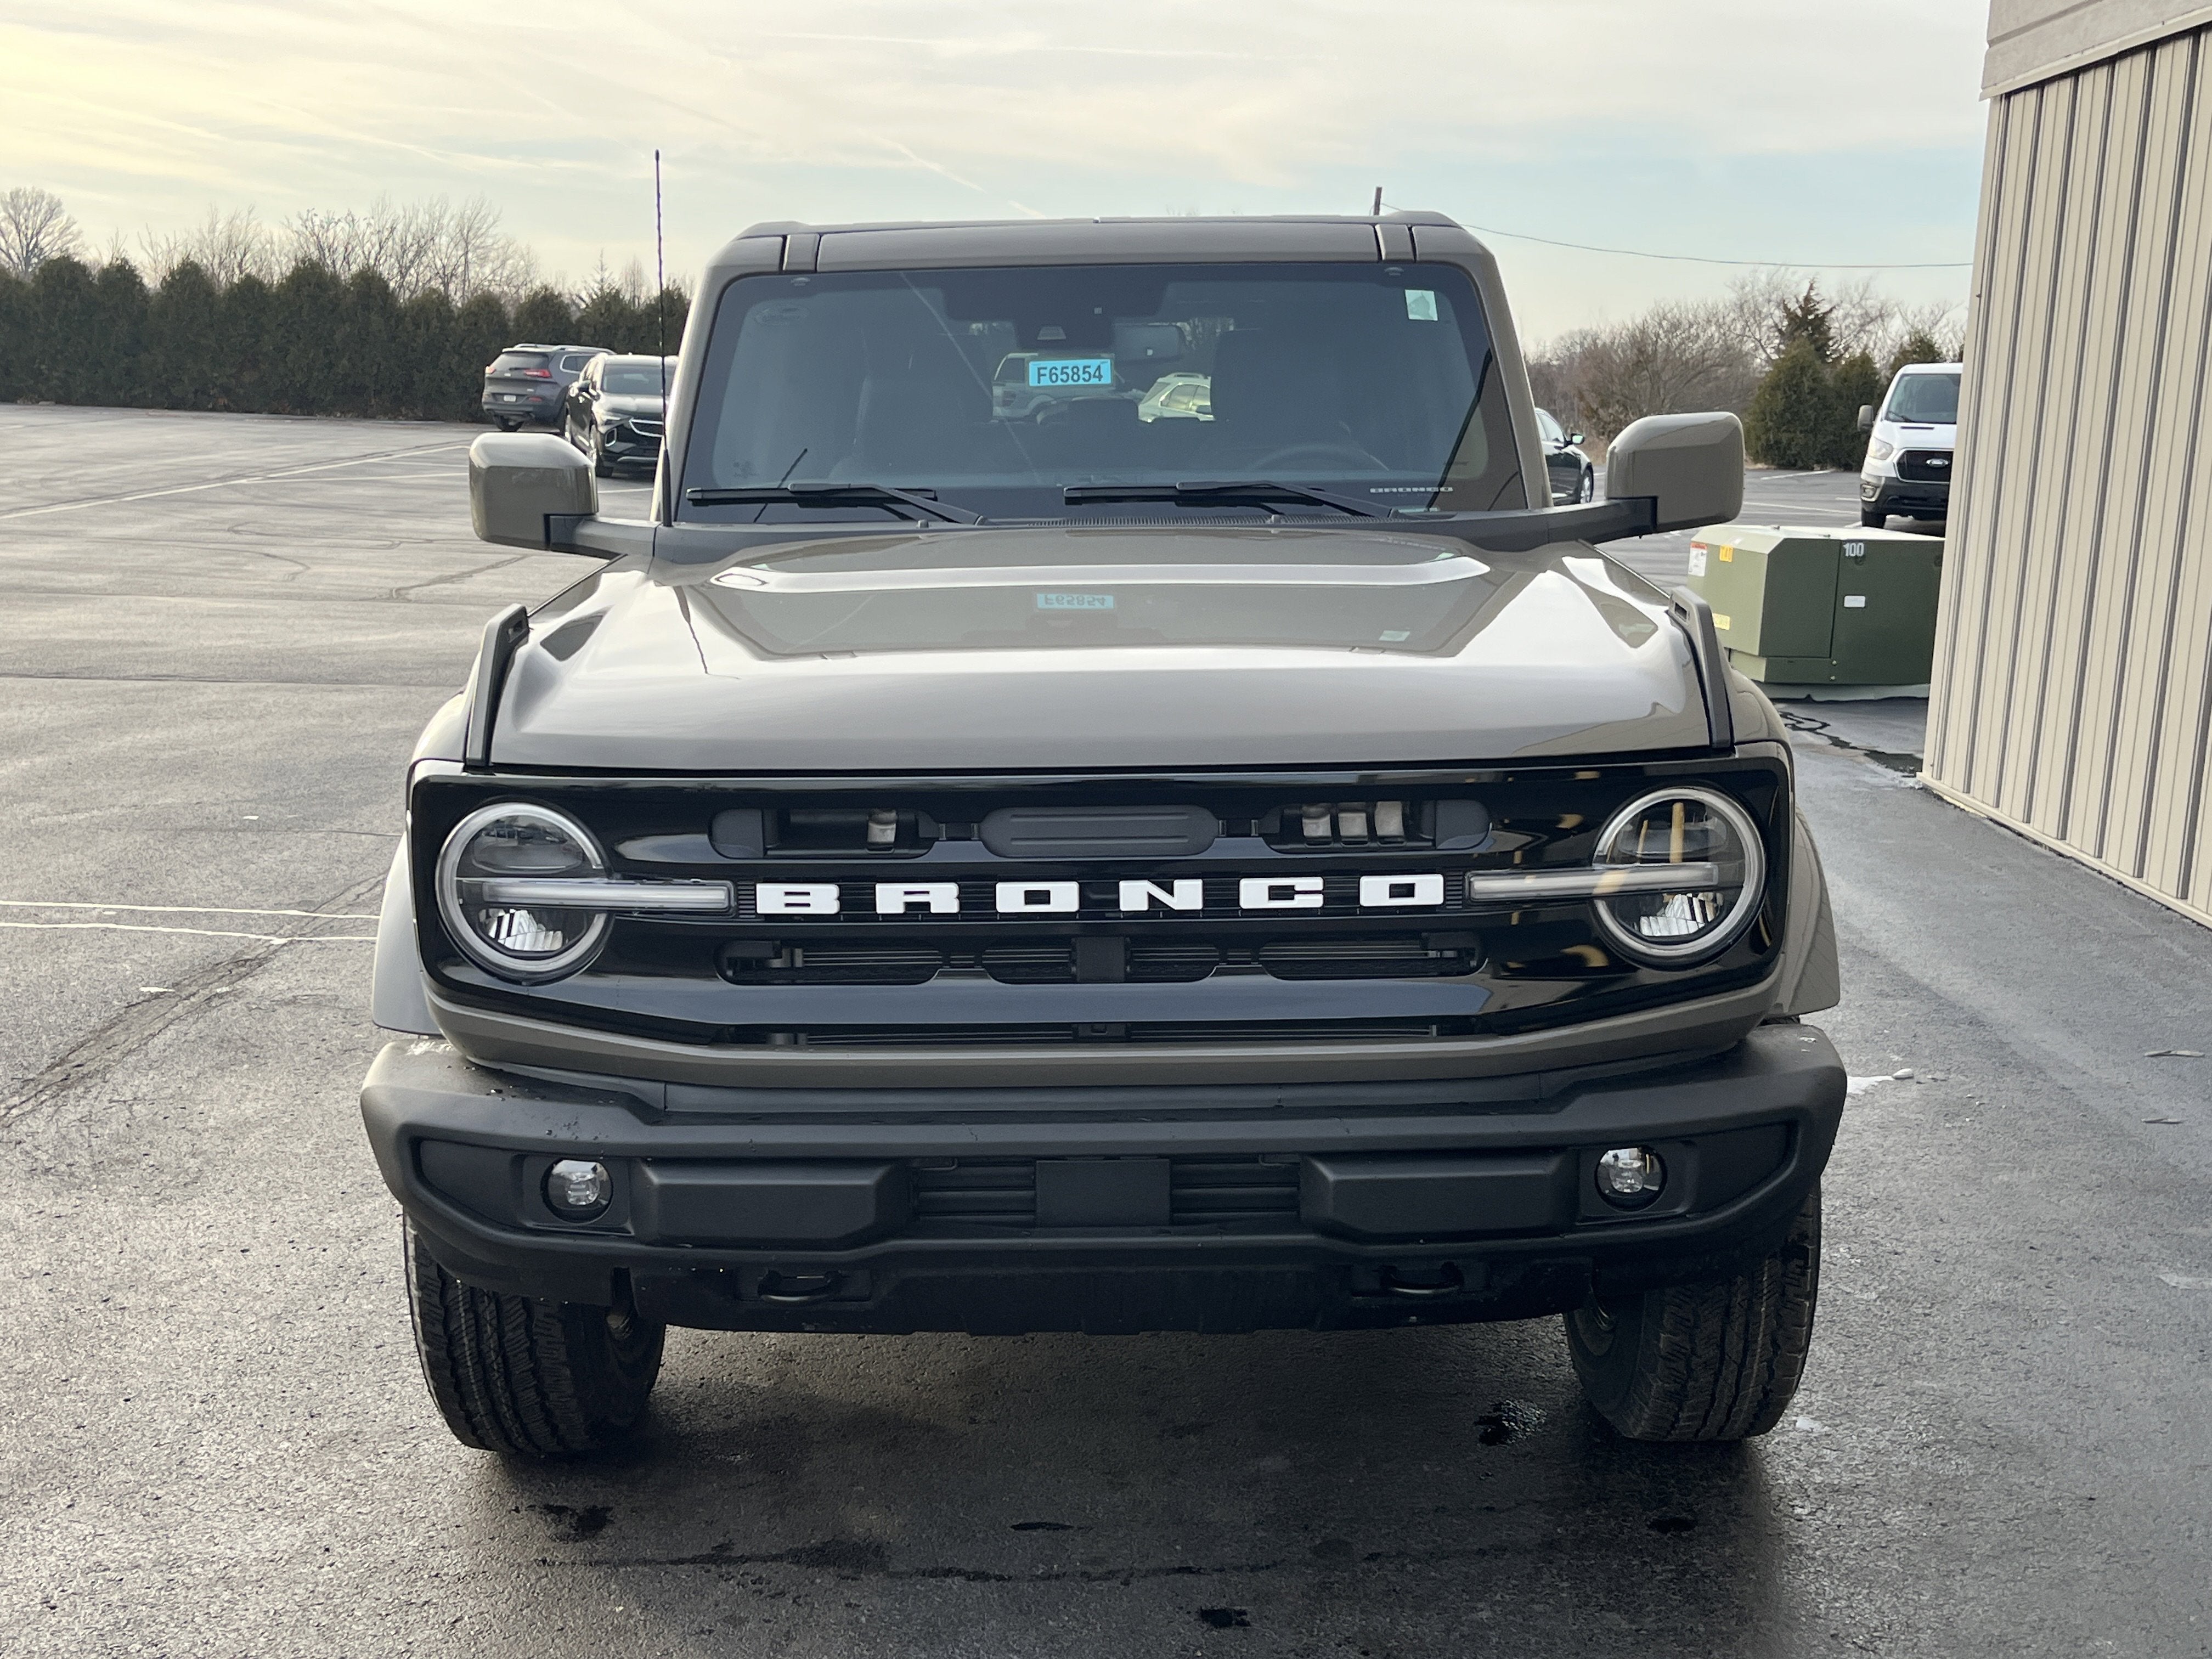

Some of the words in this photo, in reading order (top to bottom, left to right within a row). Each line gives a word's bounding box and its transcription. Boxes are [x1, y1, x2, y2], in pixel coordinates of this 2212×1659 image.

[1037, 364, 1103, 384] F65854
[1843, 543, 1864, 557] 100
[756, 873, 1444, 915] BRONCO
